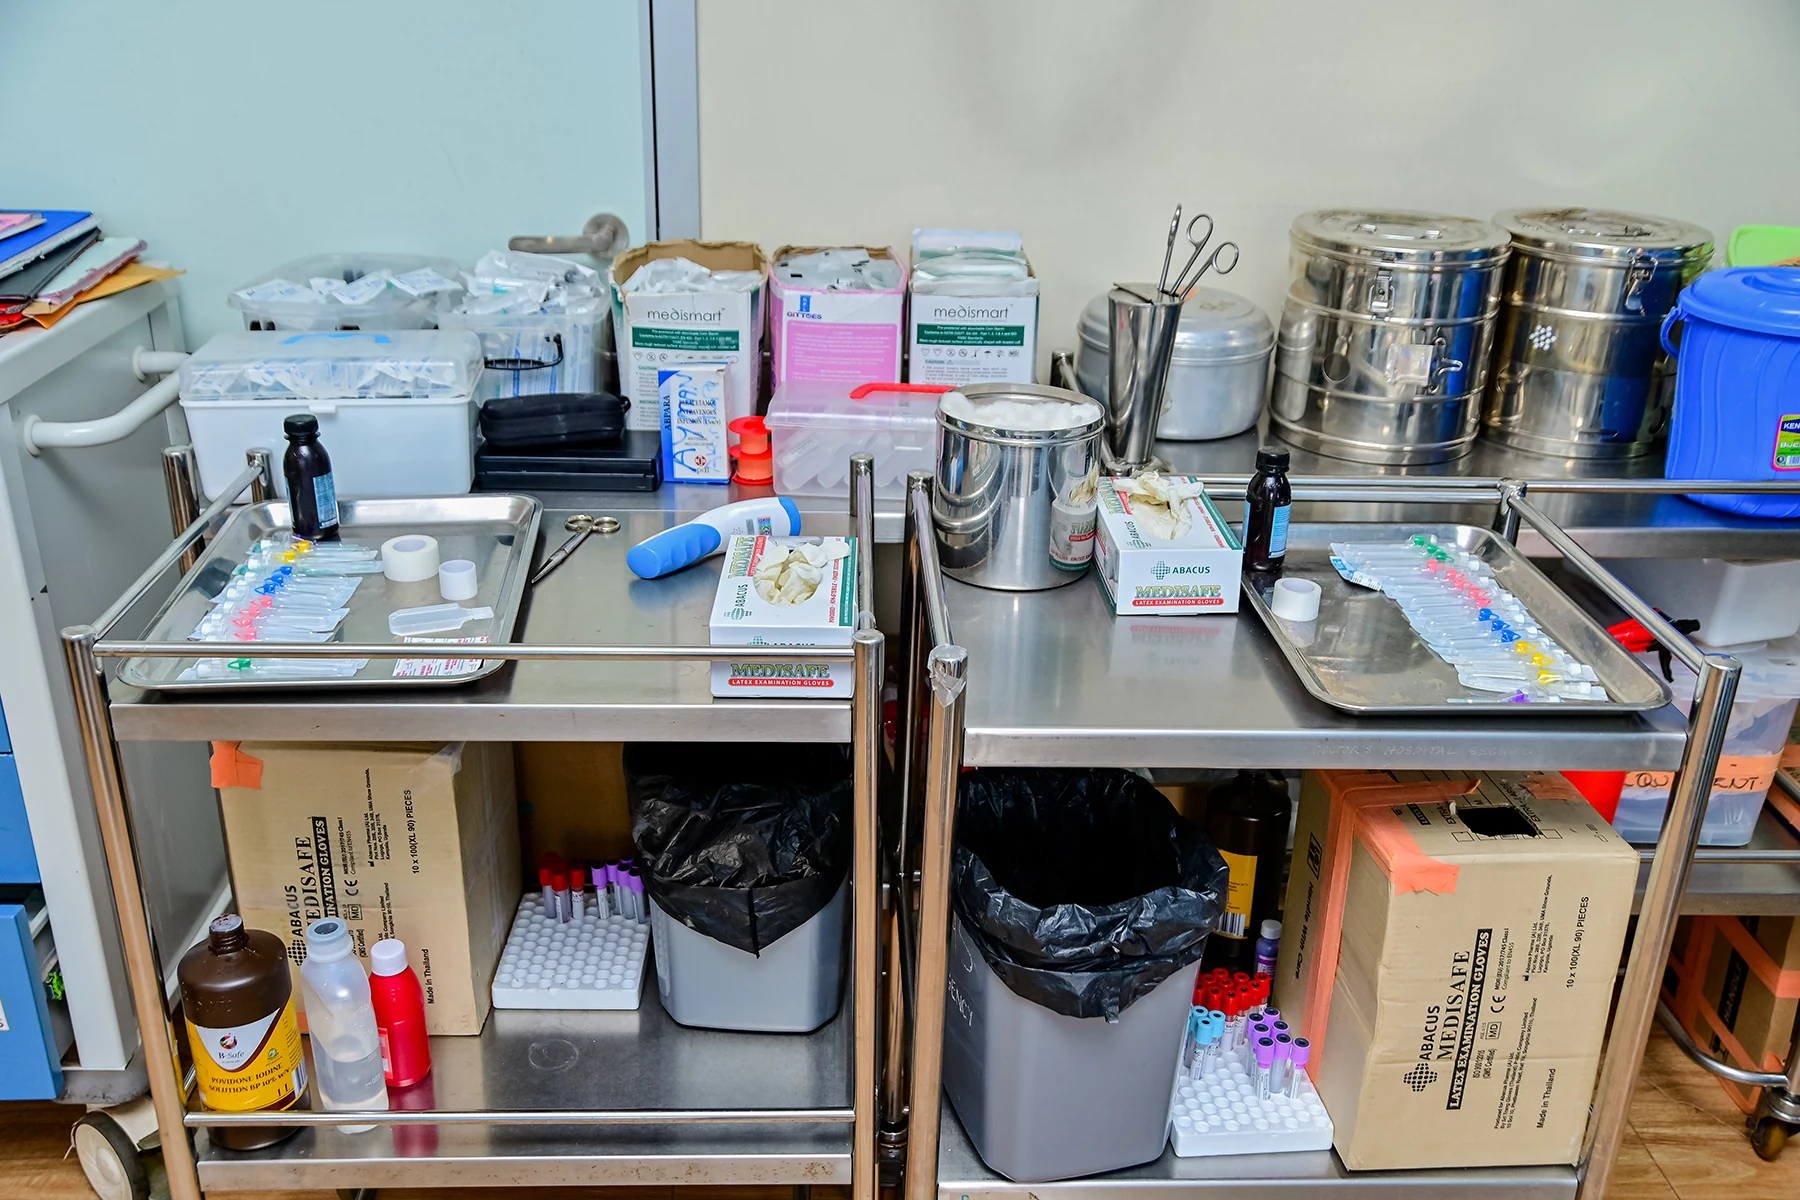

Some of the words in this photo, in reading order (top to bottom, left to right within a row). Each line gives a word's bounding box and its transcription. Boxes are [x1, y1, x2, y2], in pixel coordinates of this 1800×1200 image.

[647, 308, 722, 321] medismart
[934, 305, 1008, 318] medismart
[663, 395, 671, 430] ABPARA
[726, 535, 755, 580] MEDISAFE
[1172, 566, 1211, 574] ABACUS
[734, 583, 748, 607] ABACUS
[1135, 585, 1221, 599] MEDISAFE
[731, 664, 830, 678] MEDISAFE
[404, 790, 414, 818] PIECES
[407, 820, 416, 832] 90)
[314, 819, 330, 865] GLOVES
[408, 833, 418, 857] 100(XL
[412, 865, 420, 874] 10
[321, 868, 337, 916] INATION
[1305, 881, 1314, 923] Handle
[284, 885, 303, 937] ABACUS
[351, 905, 360, 918] MD
[1577, 897, 1589, 927] PIECES
[1574, 929, 1585, 942] 90)
[421, 949, 431, 977] Thailand
[1474, 932, 1490, 981] GLOVES
[1501, 965, 1511, 990] Compliant
[1506, 942, 1515, 958] EN455
[1569, 943, 1581, 970] 100(XL
[426, 986, 434, 1004] Made
[1566, 979, 1575, 988] 10
[1437, 951, 1470, 1060] MEDISAFE
[1490, 996, 1506, 1013] CE
[1419, 1006, 1440, 1060] ABACUS
[1456, 983, 1481, 1067] EXAMINATION
[1488, 1024, 1498, 1037] MD
[218, 1050, 245, 1059] B-Safe
[209, 1084, 248, 1093] SOLUTION
[250, 1082, 261, 1090] BP
[262, 1076, 277, 1087] 10%
[211, 1076, 253, 1085] POVIDONE
[256, 1063, 283, 1079] IODINE
[284, 1084, 290, 1092] L
[1449, 1070, 1466, 1107] LATEX
[1536, 1109, 1547, 1128] Made
[1543, 1068, 1556, 1099] Thailand
